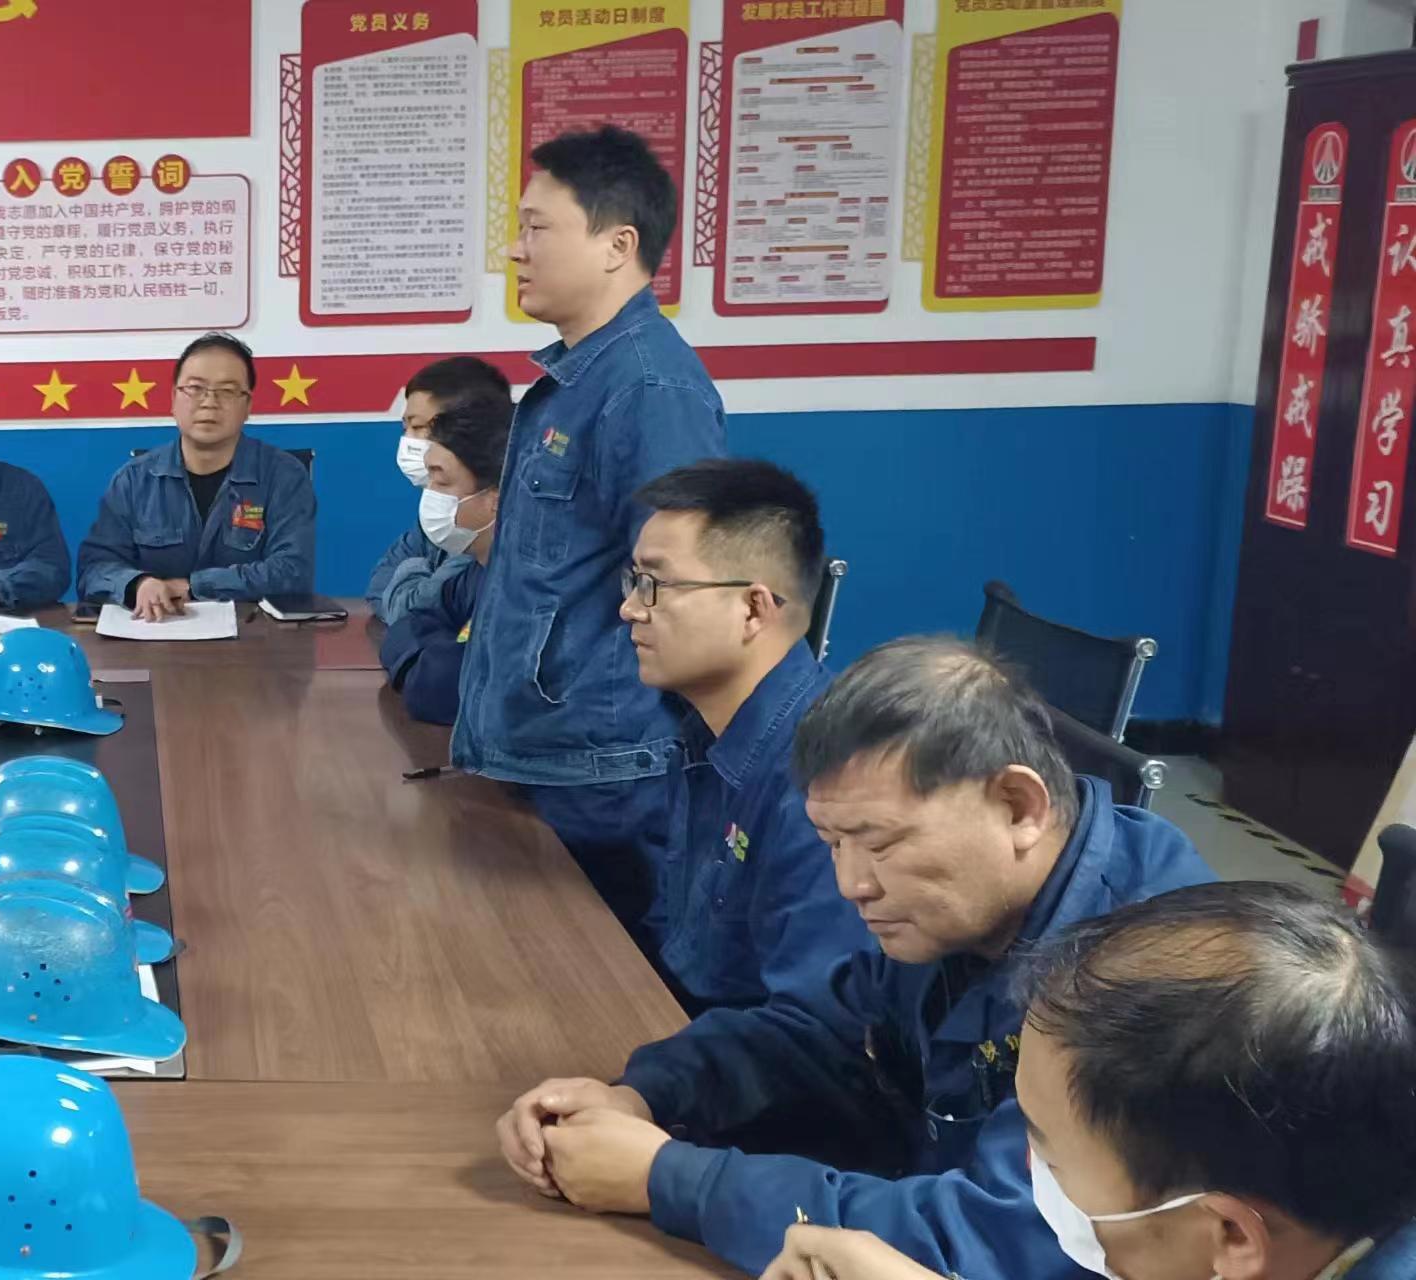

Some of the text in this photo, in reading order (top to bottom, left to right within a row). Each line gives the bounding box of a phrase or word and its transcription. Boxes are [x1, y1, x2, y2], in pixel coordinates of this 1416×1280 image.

[349, 12, 432, 32] 党员义务
[538, 7, 666, 27] 党员活动日制度
[9, 160, 184, 191] 入党誓词
[1275, 211, 1332, 513] 戒骄戒躁
[1364, 223, 1416, 537] 认真学习
